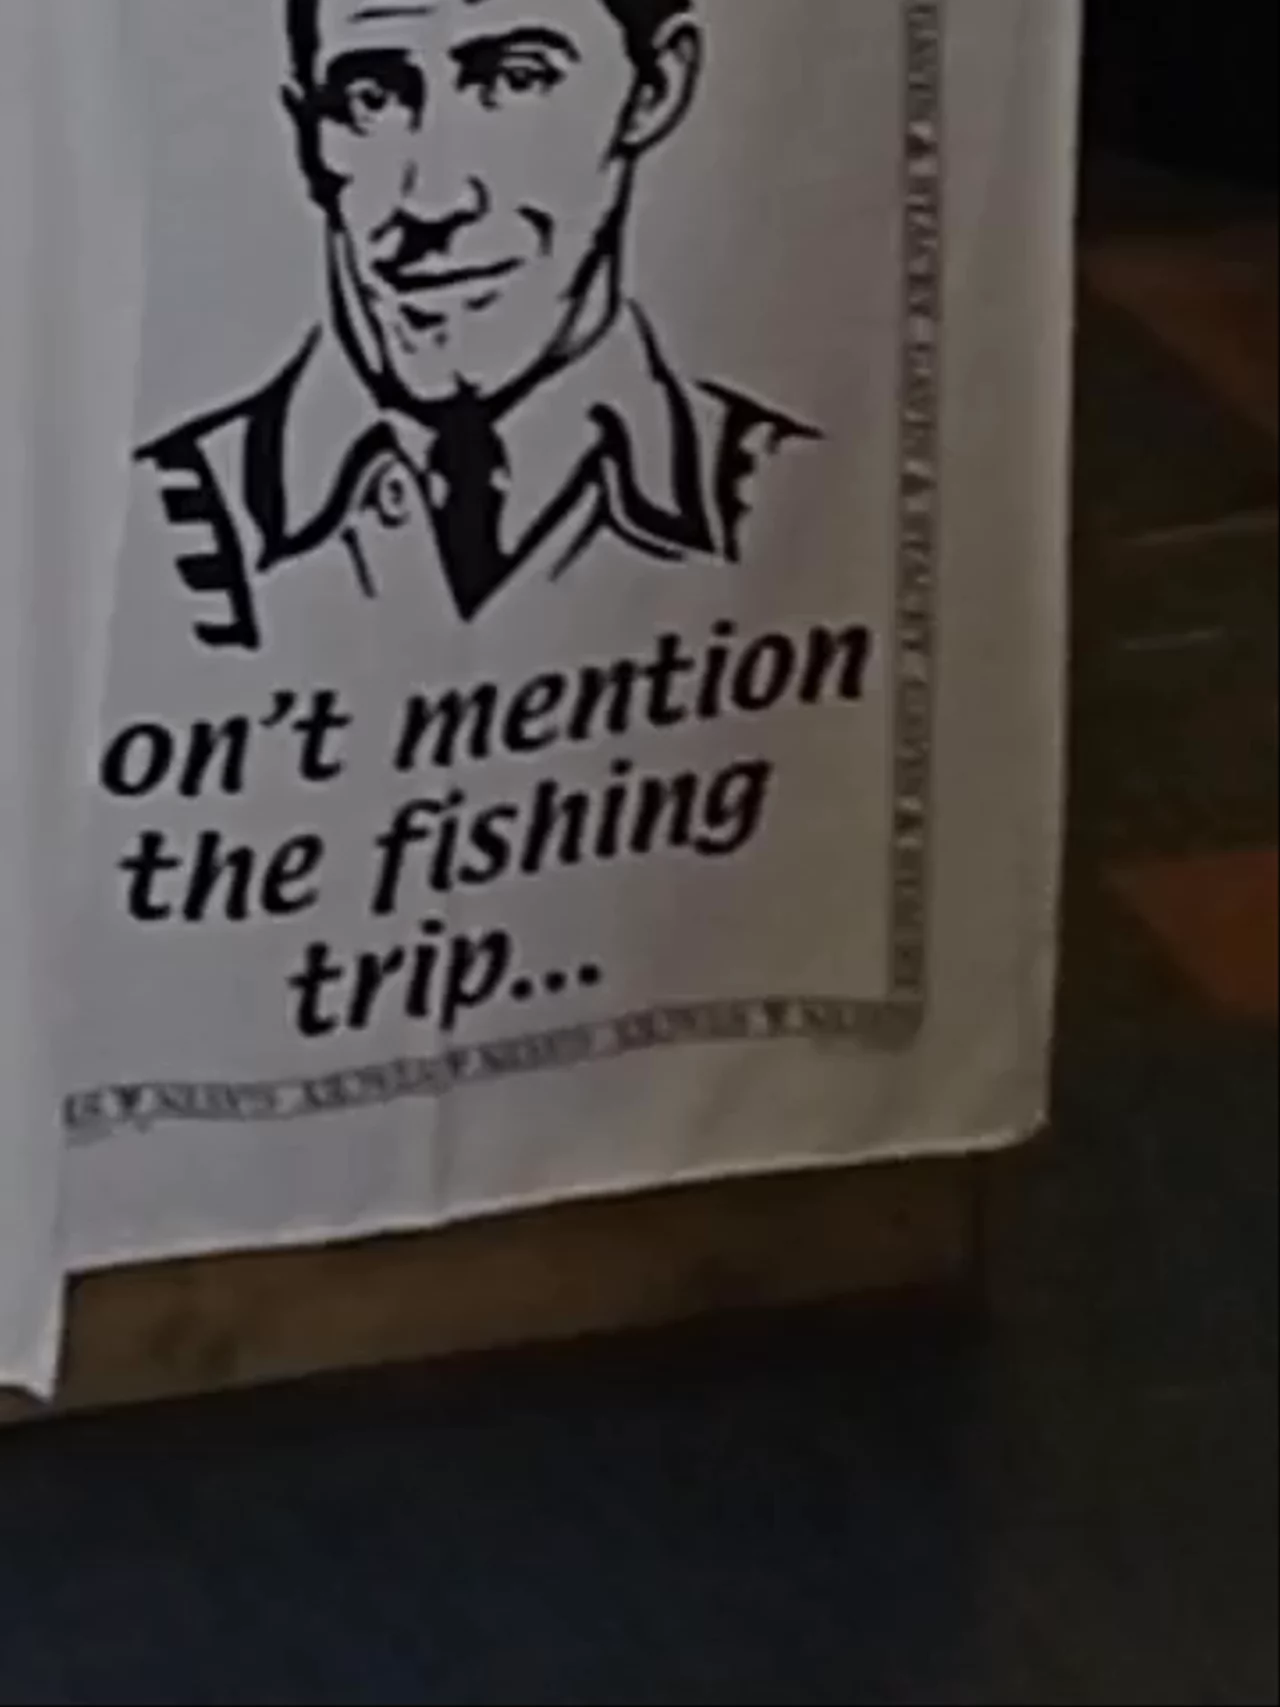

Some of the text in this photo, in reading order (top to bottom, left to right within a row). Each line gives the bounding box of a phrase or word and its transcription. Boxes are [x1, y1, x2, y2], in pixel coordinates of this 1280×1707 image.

[394, 620, 874, 772] mention
[119, 754, 774, 924] the fishing
